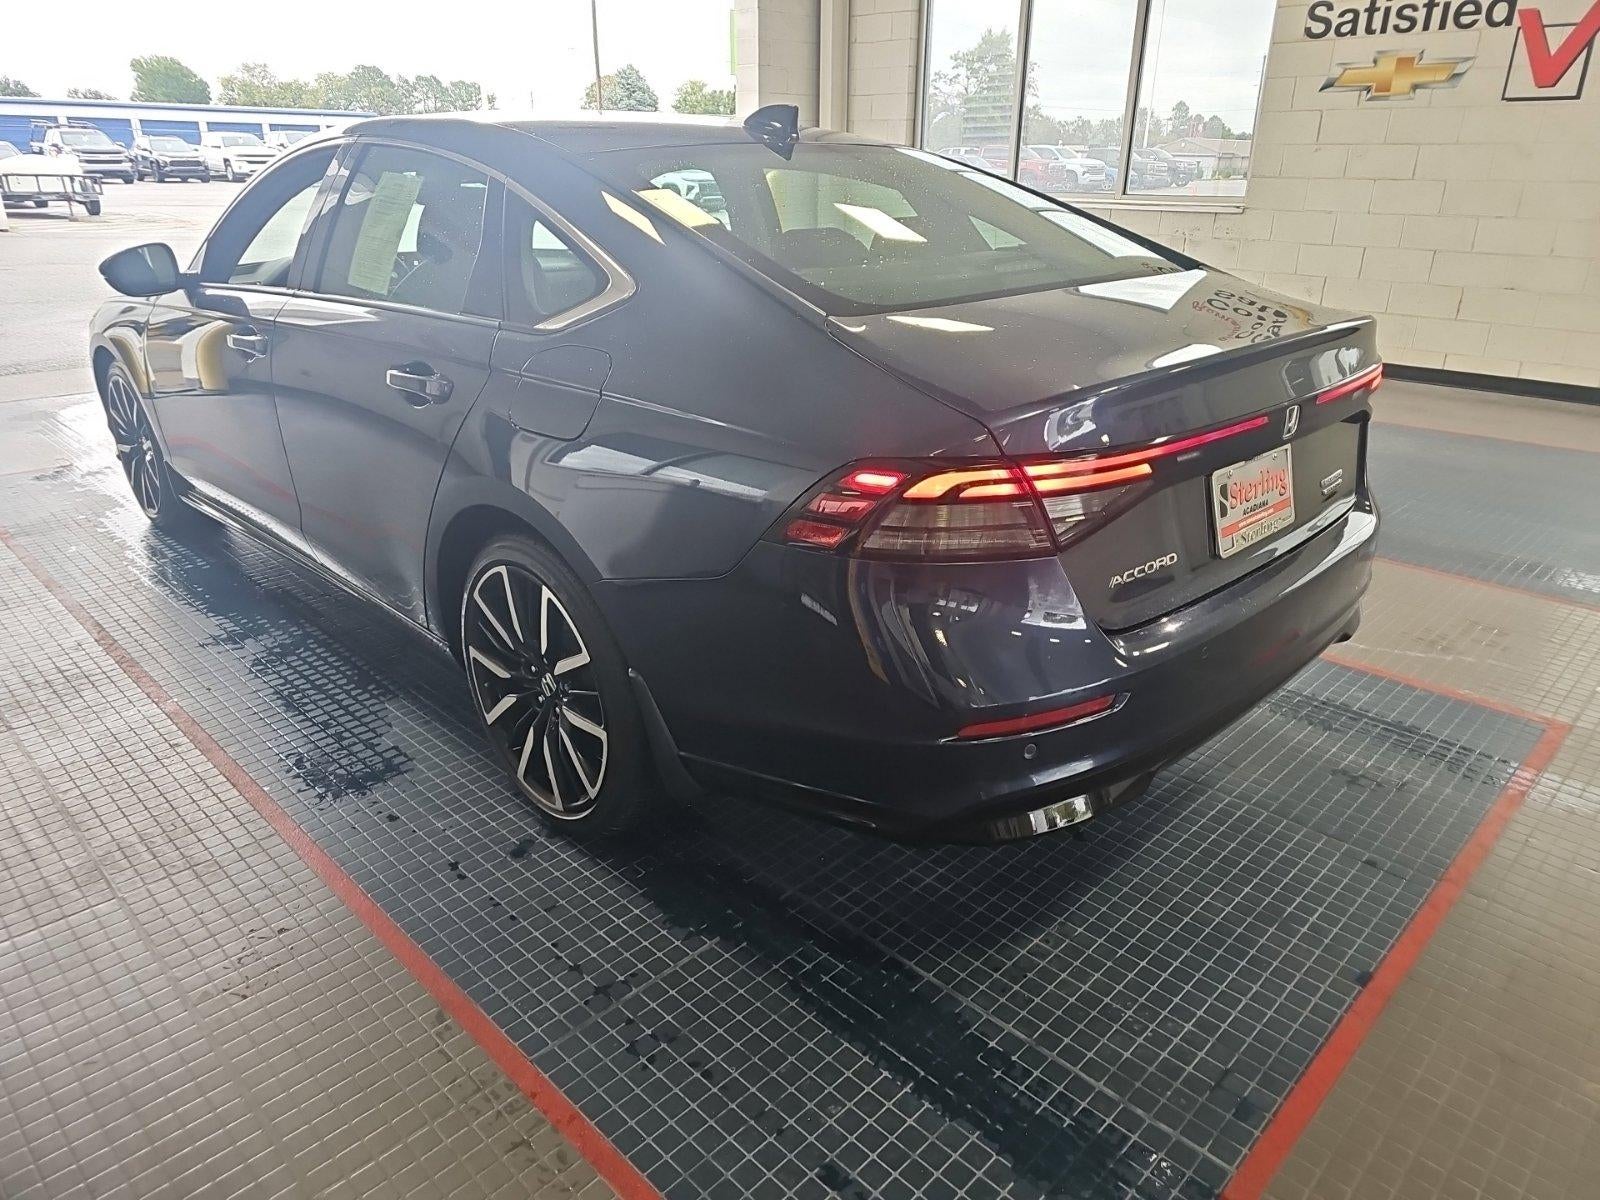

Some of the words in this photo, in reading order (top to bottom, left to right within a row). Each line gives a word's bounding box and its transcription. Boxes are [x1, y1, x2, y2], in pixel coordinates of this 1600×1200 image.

[1304, 0, 1518, 40] Satisfied
[1229, 468, 1287, 510] Sterling
[1108, 552, 1178, 588] ACCORD
